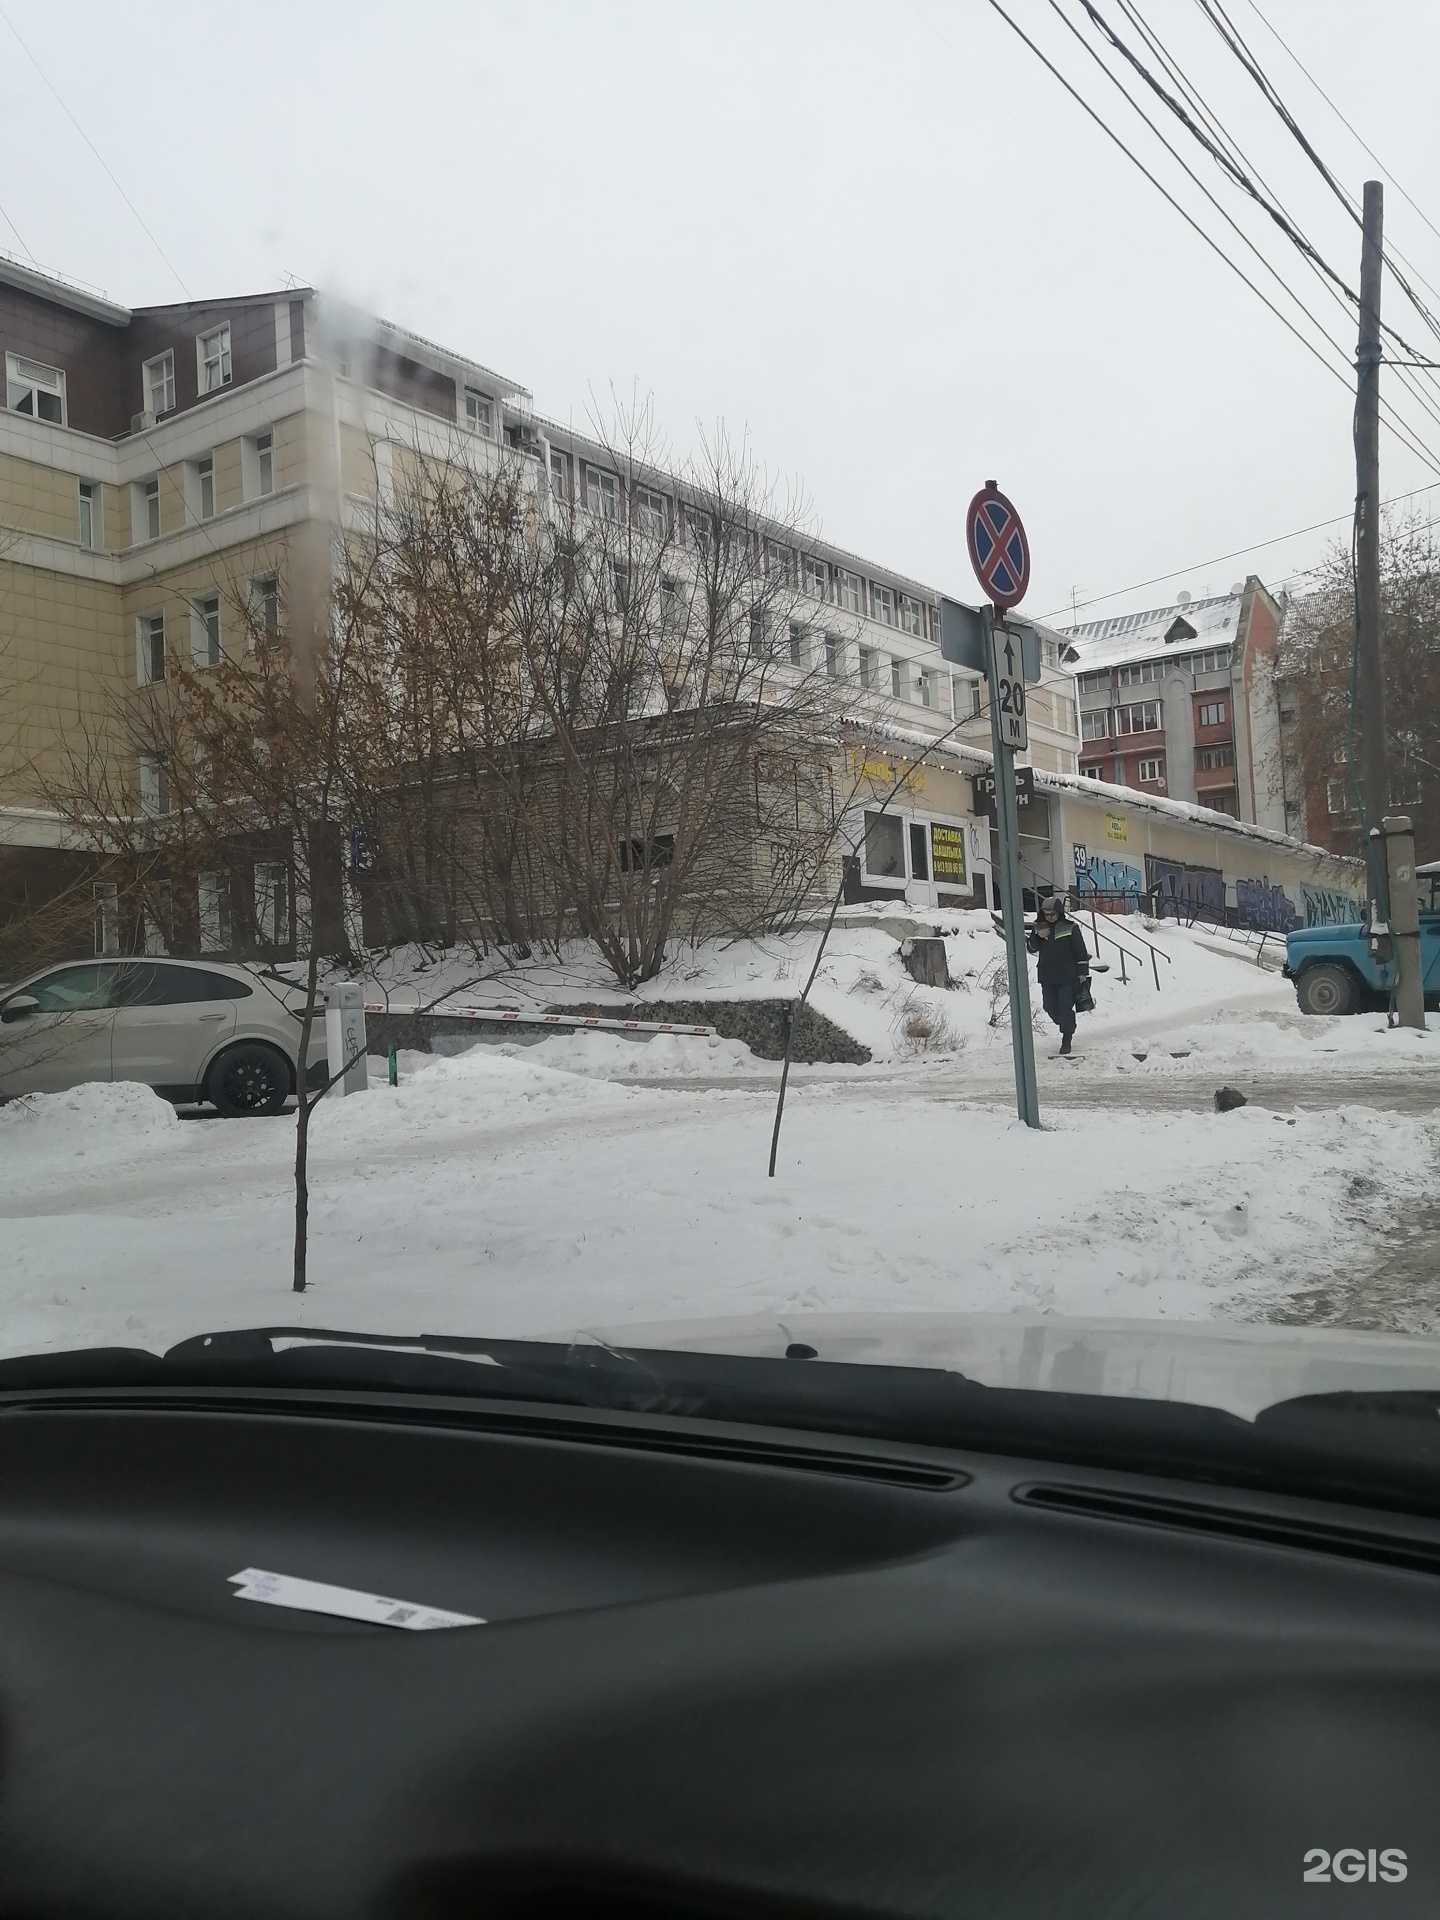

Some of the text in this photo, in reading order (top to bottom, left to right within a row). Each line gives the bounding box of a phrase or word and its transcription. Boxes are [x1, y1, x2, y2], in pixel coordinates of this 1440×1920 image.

[999, 679, 1024, 716] 20
[977, 775, 1025, 792] Грь
[933, 827, 961, 842] ДОСТАВКА
[1074, 847, 1086, 867] 39
